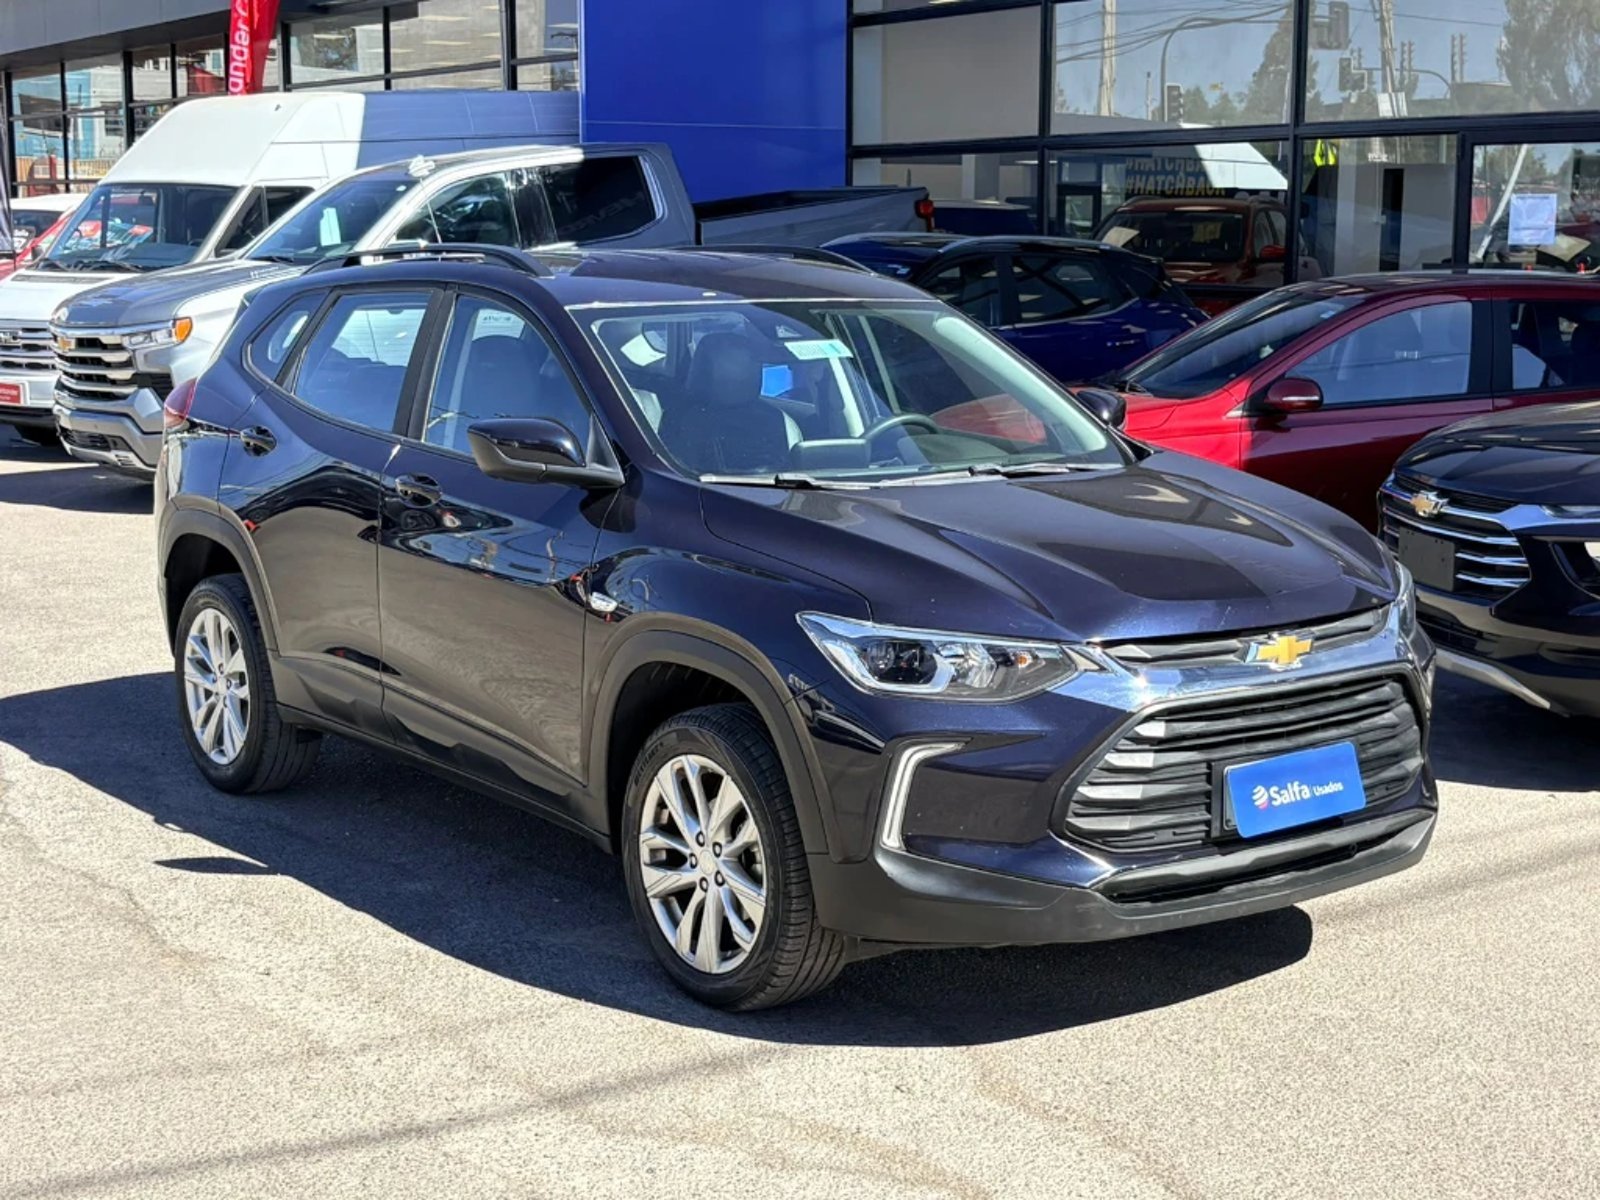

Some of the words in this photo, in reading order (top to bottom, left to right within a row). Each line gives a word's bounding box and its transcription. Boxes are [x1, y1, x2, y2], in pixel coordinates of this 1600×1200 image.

[229, 18, 250, 93] ander
[1269, 781, 1310, 806] Salfa
[1313, 782, 1344, 796] Usados
